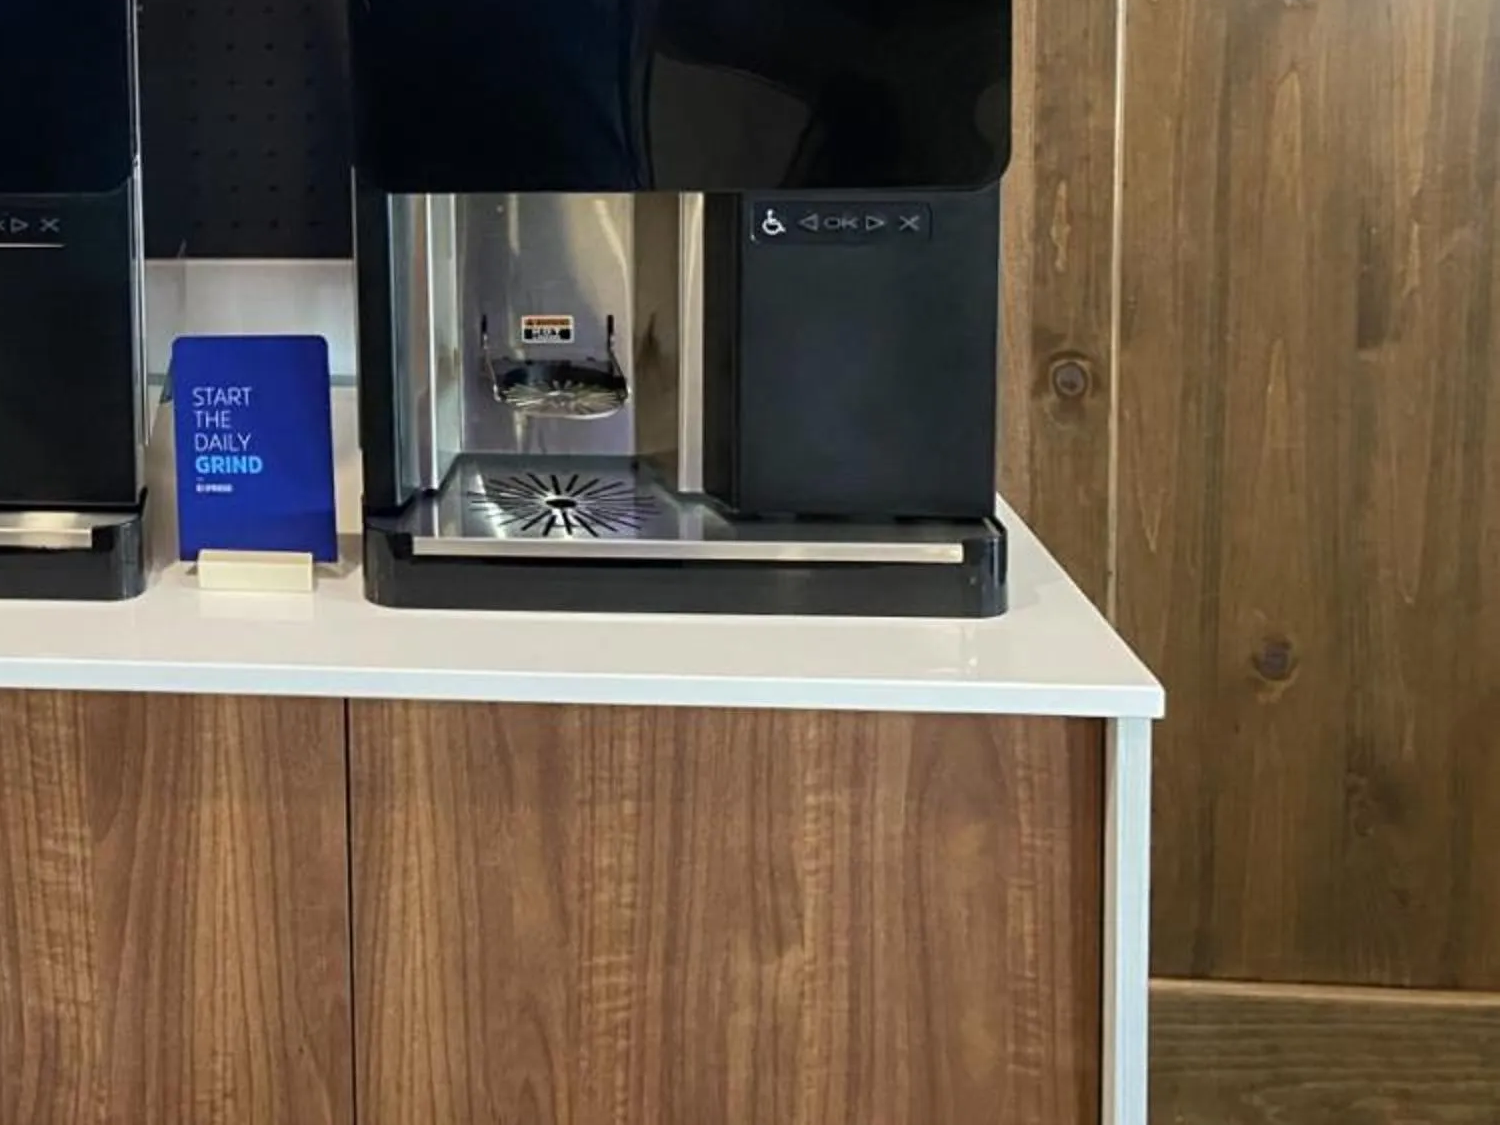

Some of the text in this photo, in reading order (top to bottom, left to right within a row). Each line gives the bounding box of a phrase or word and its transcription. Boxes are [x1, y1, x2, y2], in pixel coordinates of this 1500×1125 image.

[192, 386, 252, 407] START
[193, 410, 231, 429] THE
[195, 433, 252, 452] DAILY
[195, 456, 263, 475] GRIND
